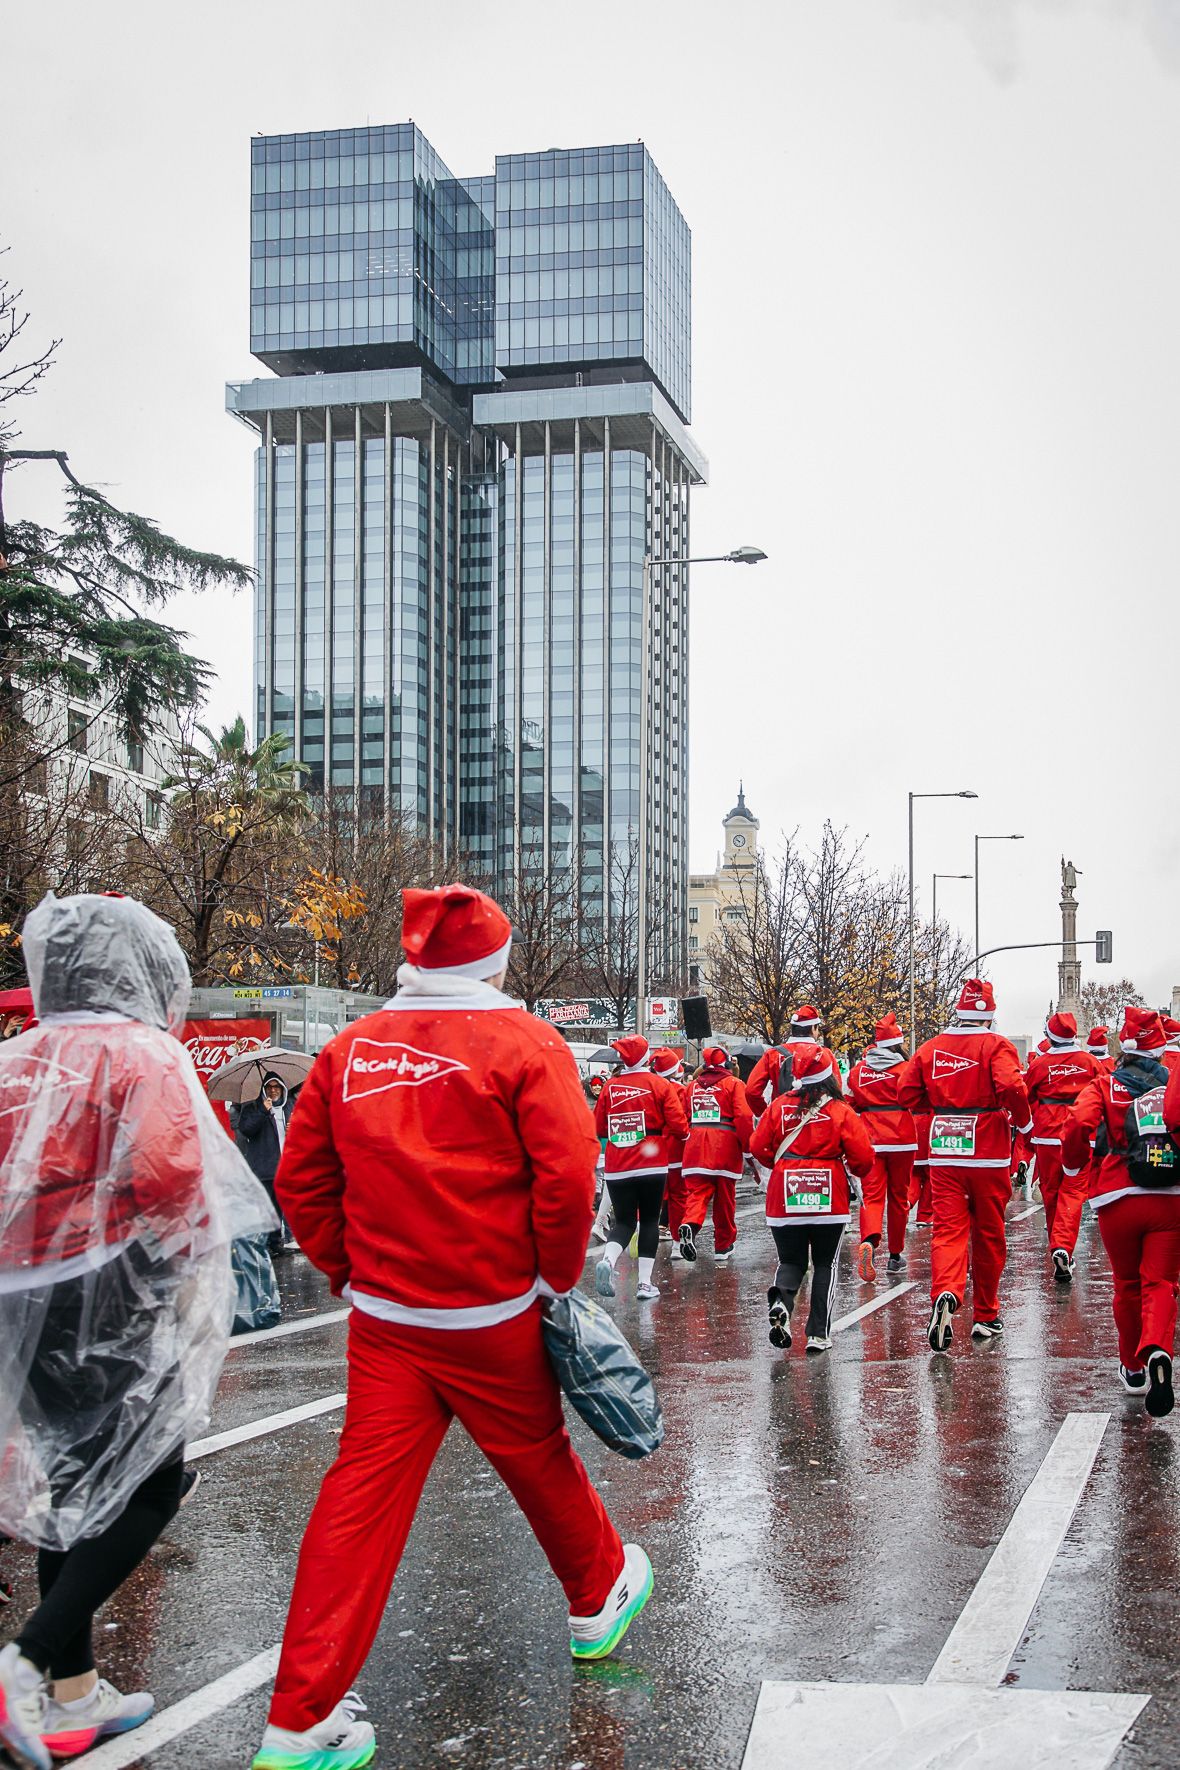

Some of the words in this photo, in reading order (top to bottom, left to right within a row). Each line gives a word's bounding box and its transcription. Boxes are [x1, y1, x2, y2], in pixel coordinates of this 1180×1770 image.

[616, 1131, 638, 1142] 7316
[940, 1136, 963, 1147] 1491
[795, 1194, 821, 1205] 1490
